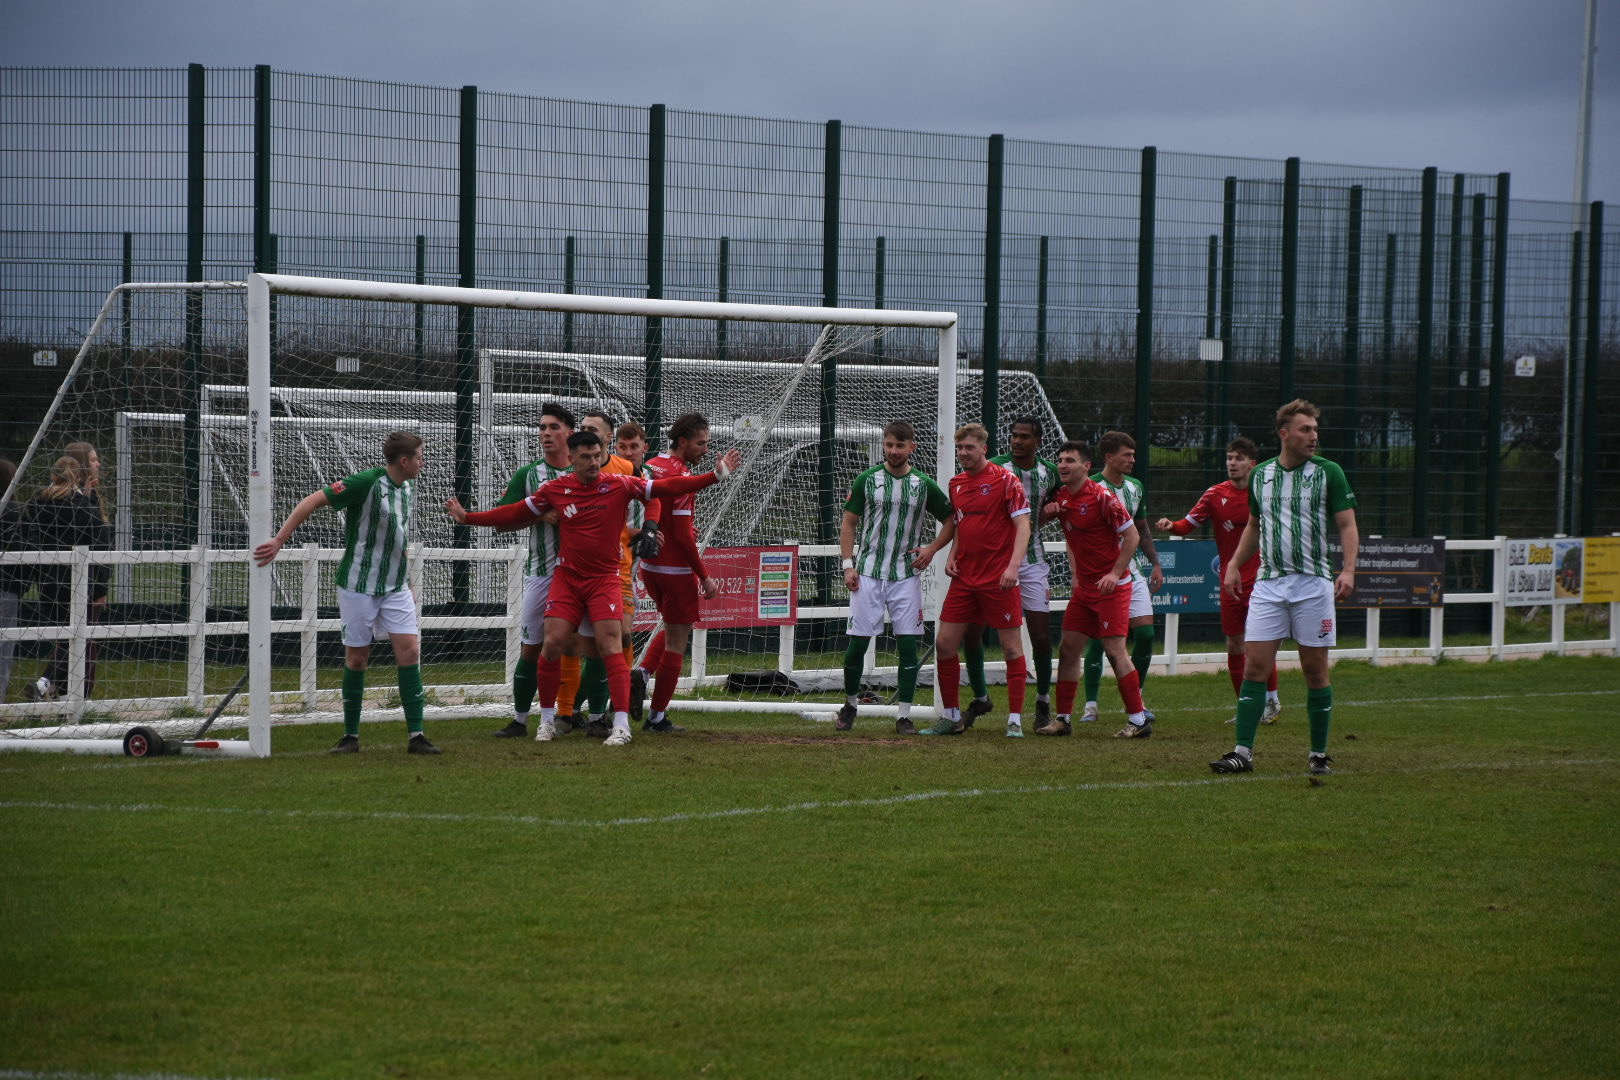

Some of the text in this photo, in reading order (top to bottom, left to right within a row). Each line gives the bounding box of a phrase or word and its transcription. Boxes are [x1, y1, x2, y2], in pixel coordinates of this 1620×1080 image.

[1404, 544, 1422, 553] Football
[1422, 544, 1434, 553] Club
[727, 578, 742, 594] 522
